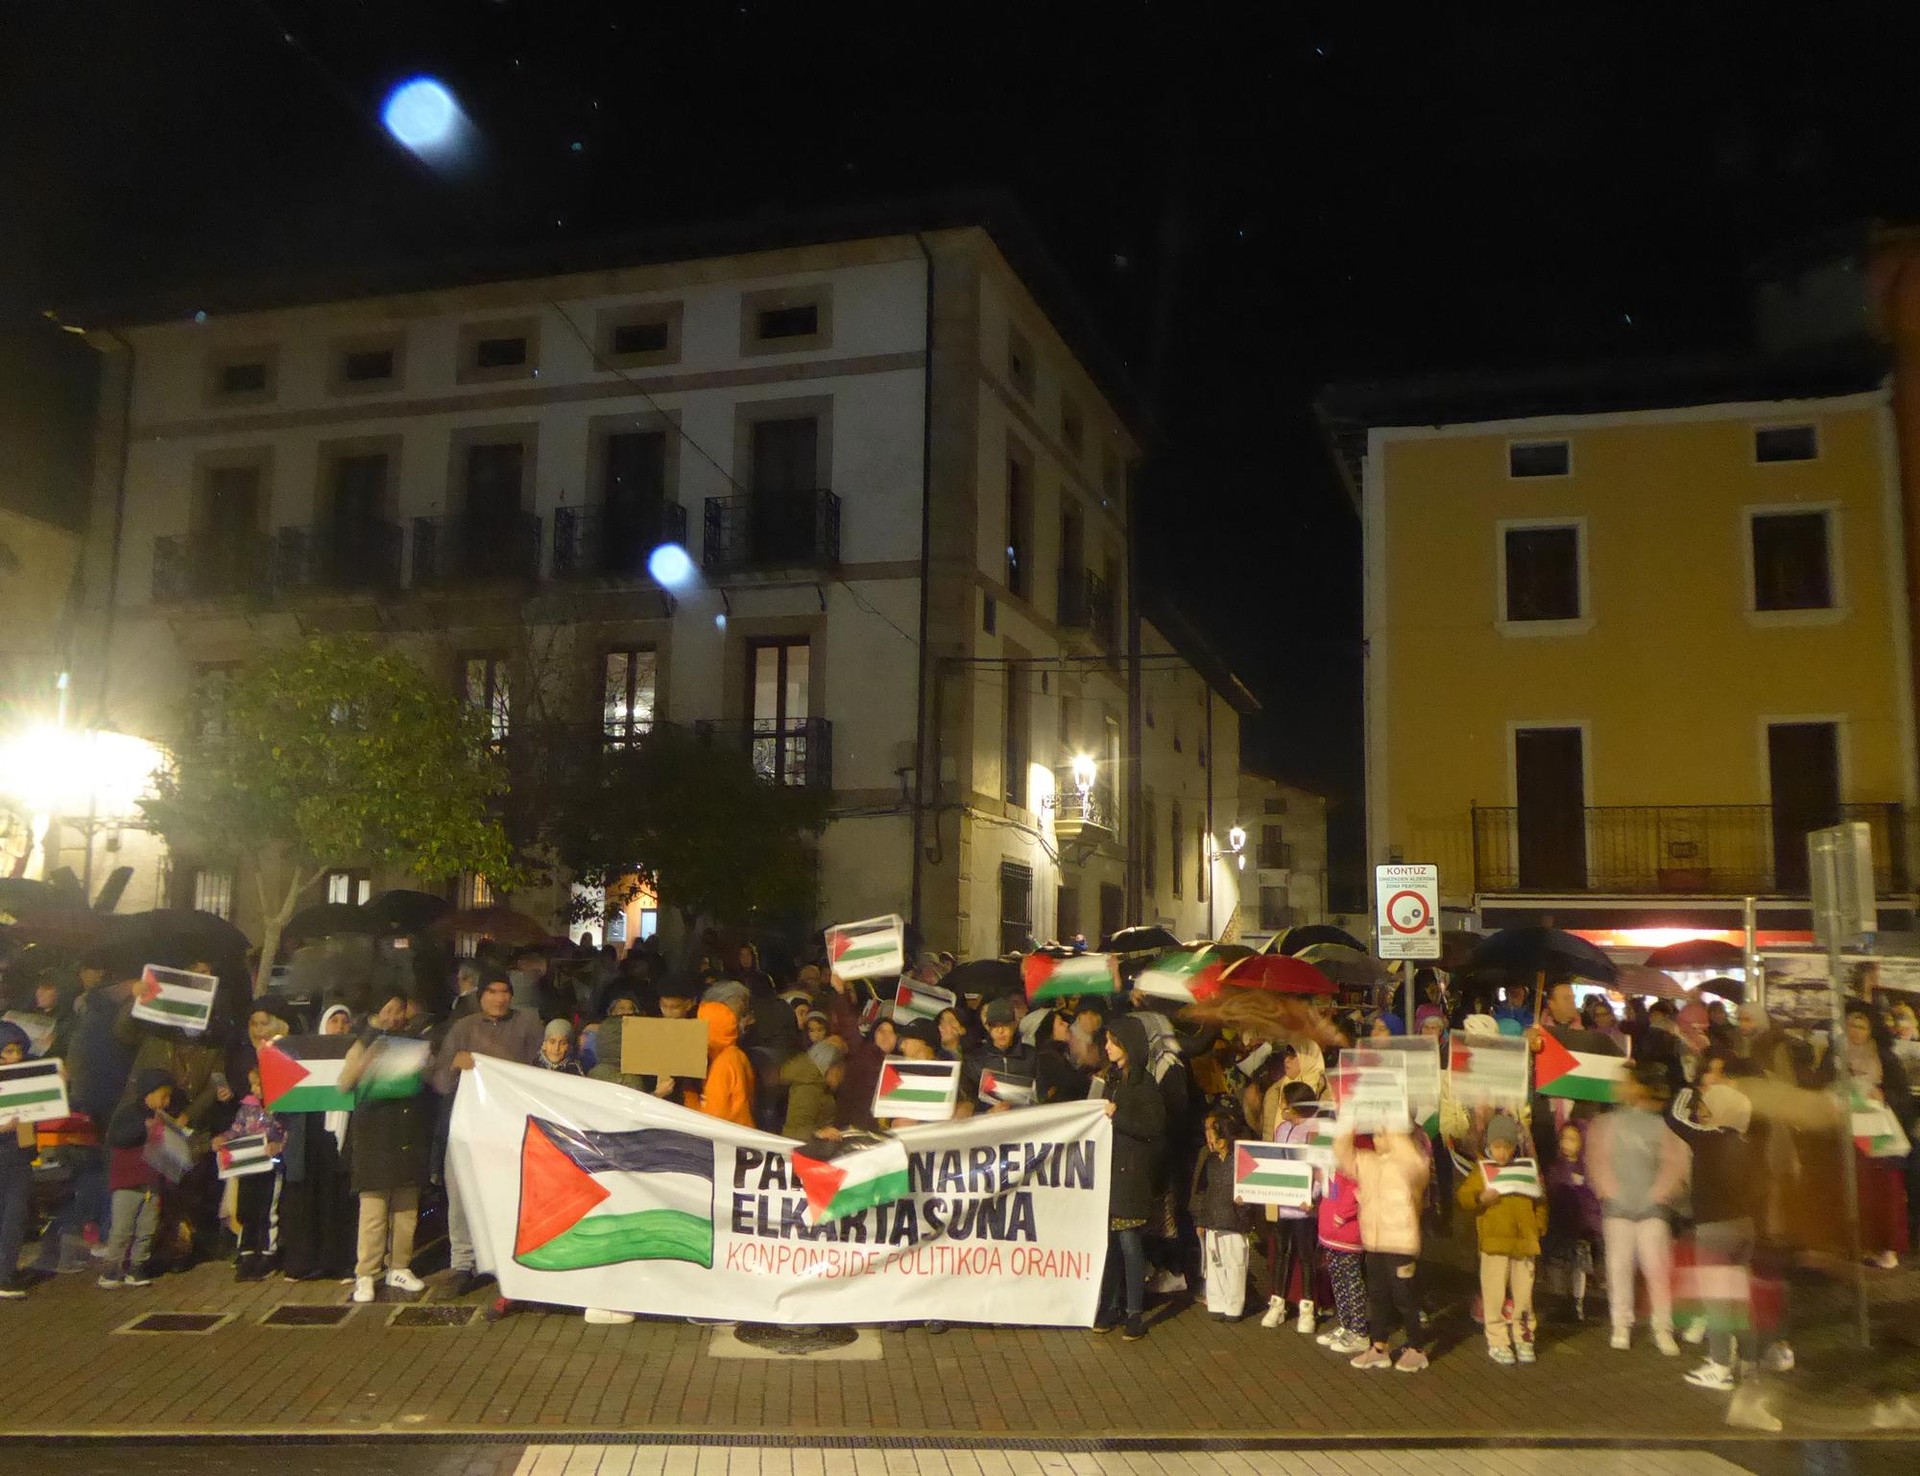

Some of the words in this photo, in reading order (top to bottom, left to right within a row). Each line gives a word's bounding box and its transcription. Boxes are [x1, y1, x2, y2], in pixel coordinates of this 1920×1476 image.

[1386, 867, 1427, 875] KONTUZ
[732, 1140, 1096, 1191] PANAREKIN
[726, 1242, 880, 1279] KONPONBIDE
[884, 1244, 1003, 1276] POLITIKOA
[1010, 1247, 1091, 1281] ORAIN!
